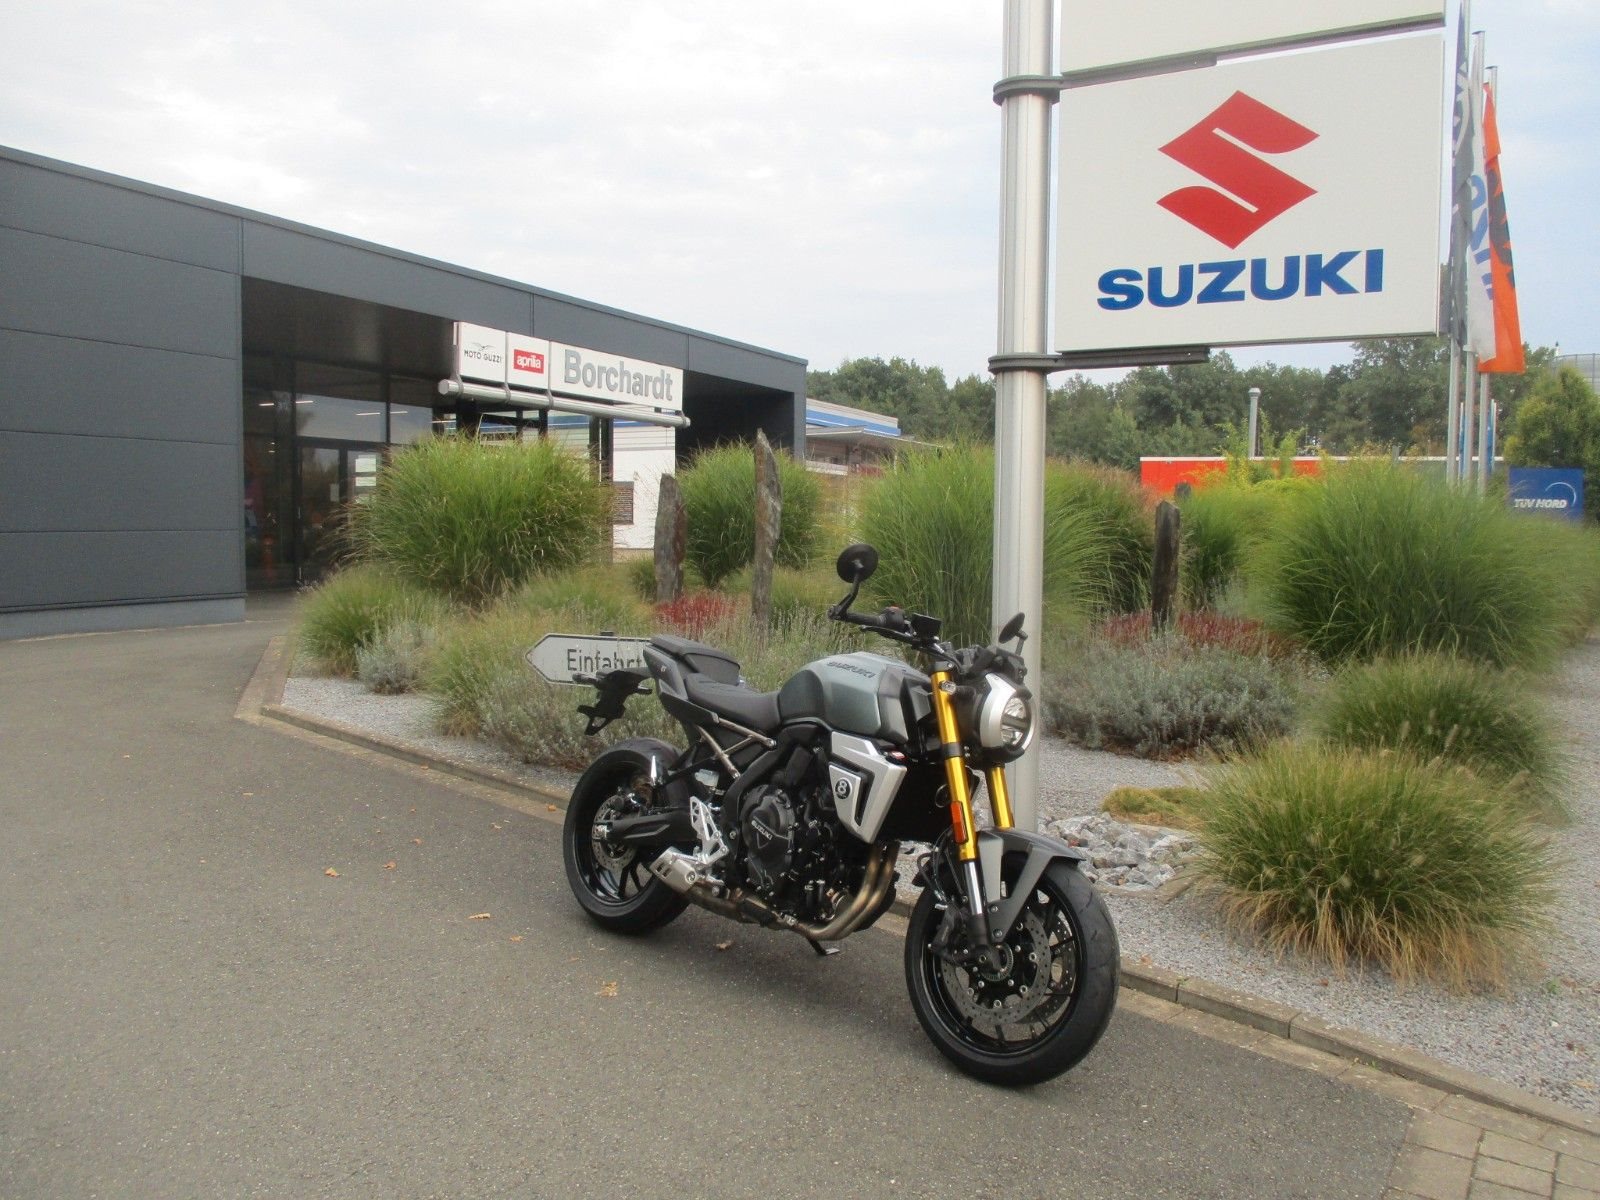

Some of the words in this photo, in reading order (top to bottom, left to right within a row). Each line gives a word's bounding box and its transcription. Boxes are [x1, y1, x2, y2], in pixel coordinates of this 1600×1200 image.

[1097, 248, 1384, 311] SUZUKI
[464, 349, 482, 360] MOTO
[483, 354, 502, 363] GUZZI
[517, 355, 542, 369] aprilia
[564, 348, 673, 401] Borchardt
